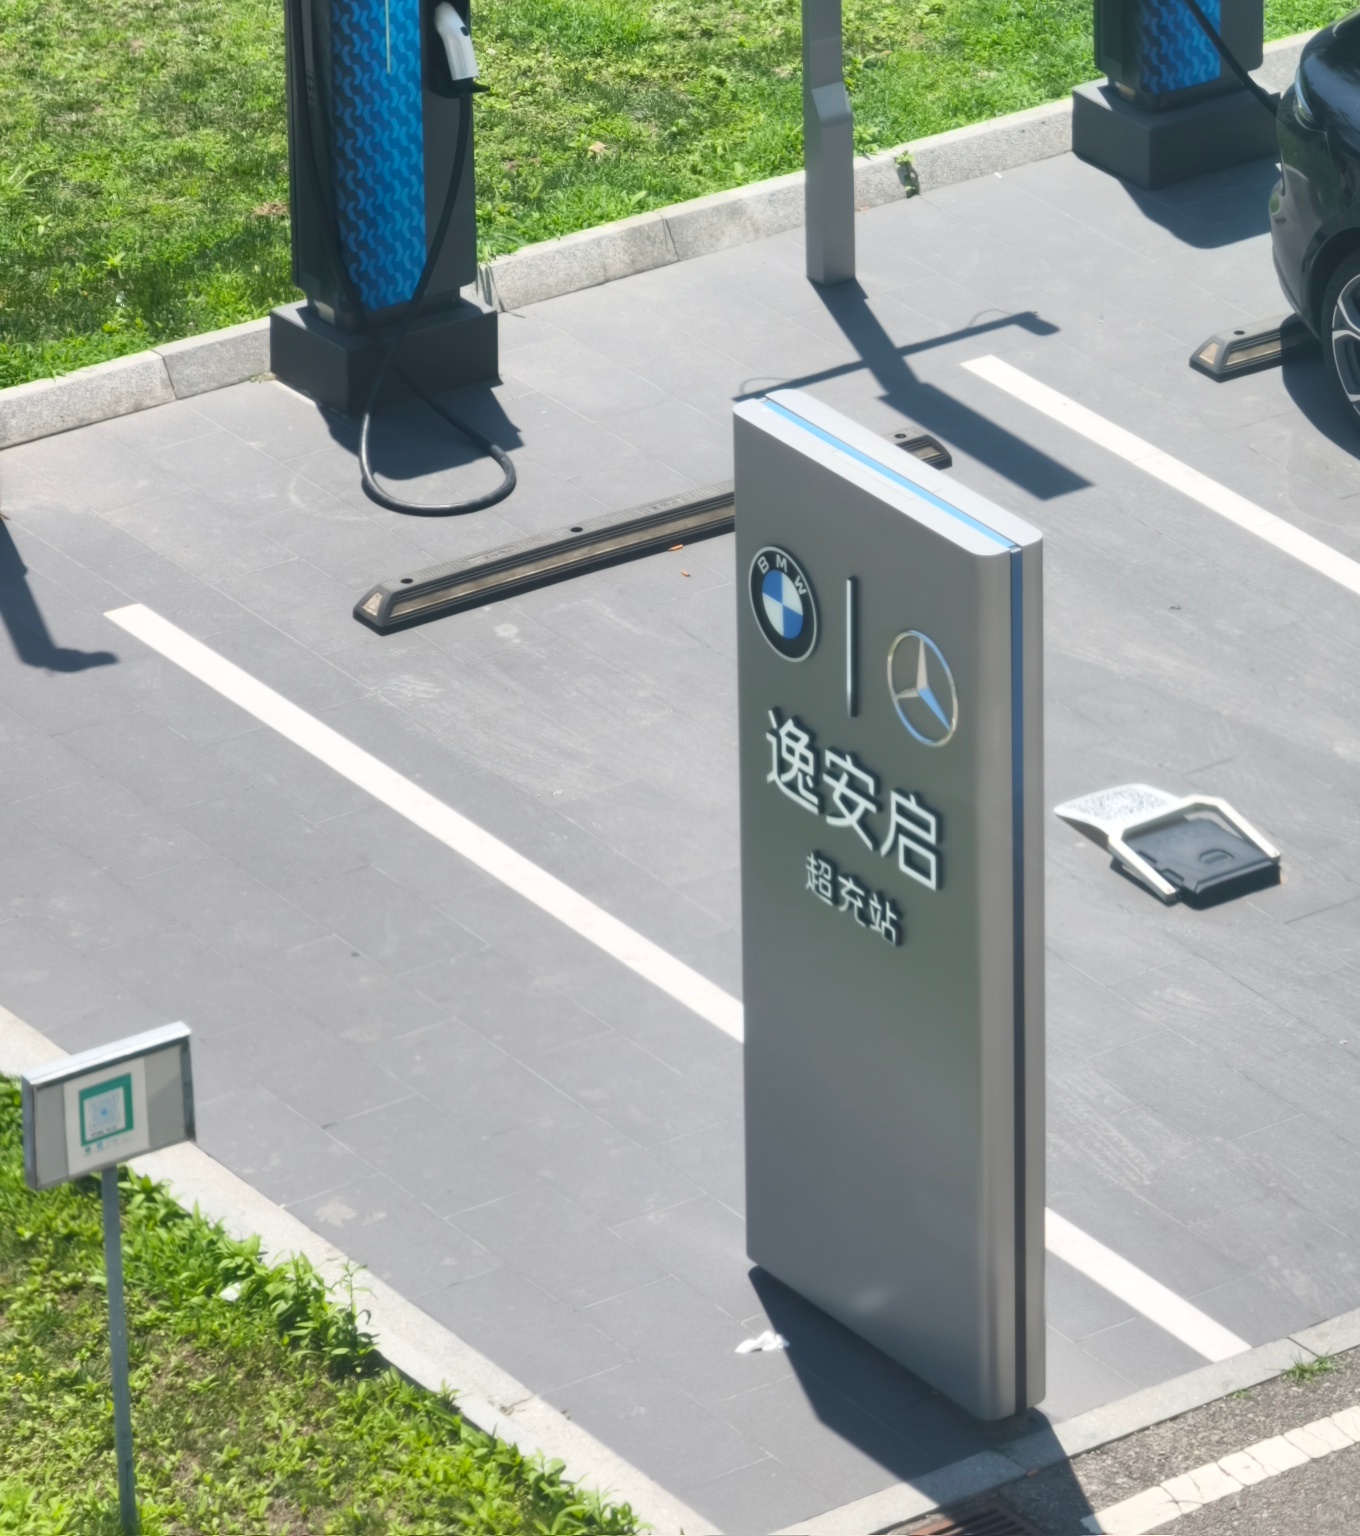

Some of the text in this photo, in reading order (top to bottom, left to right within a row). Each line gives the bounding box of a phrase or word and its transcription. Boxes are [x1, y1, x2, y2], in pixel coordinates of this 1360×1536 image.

[757, 553, 808, 595] BMW
[766, 708, 940, 891] 逸安启
[805, 850, 900, 947] 超充站
